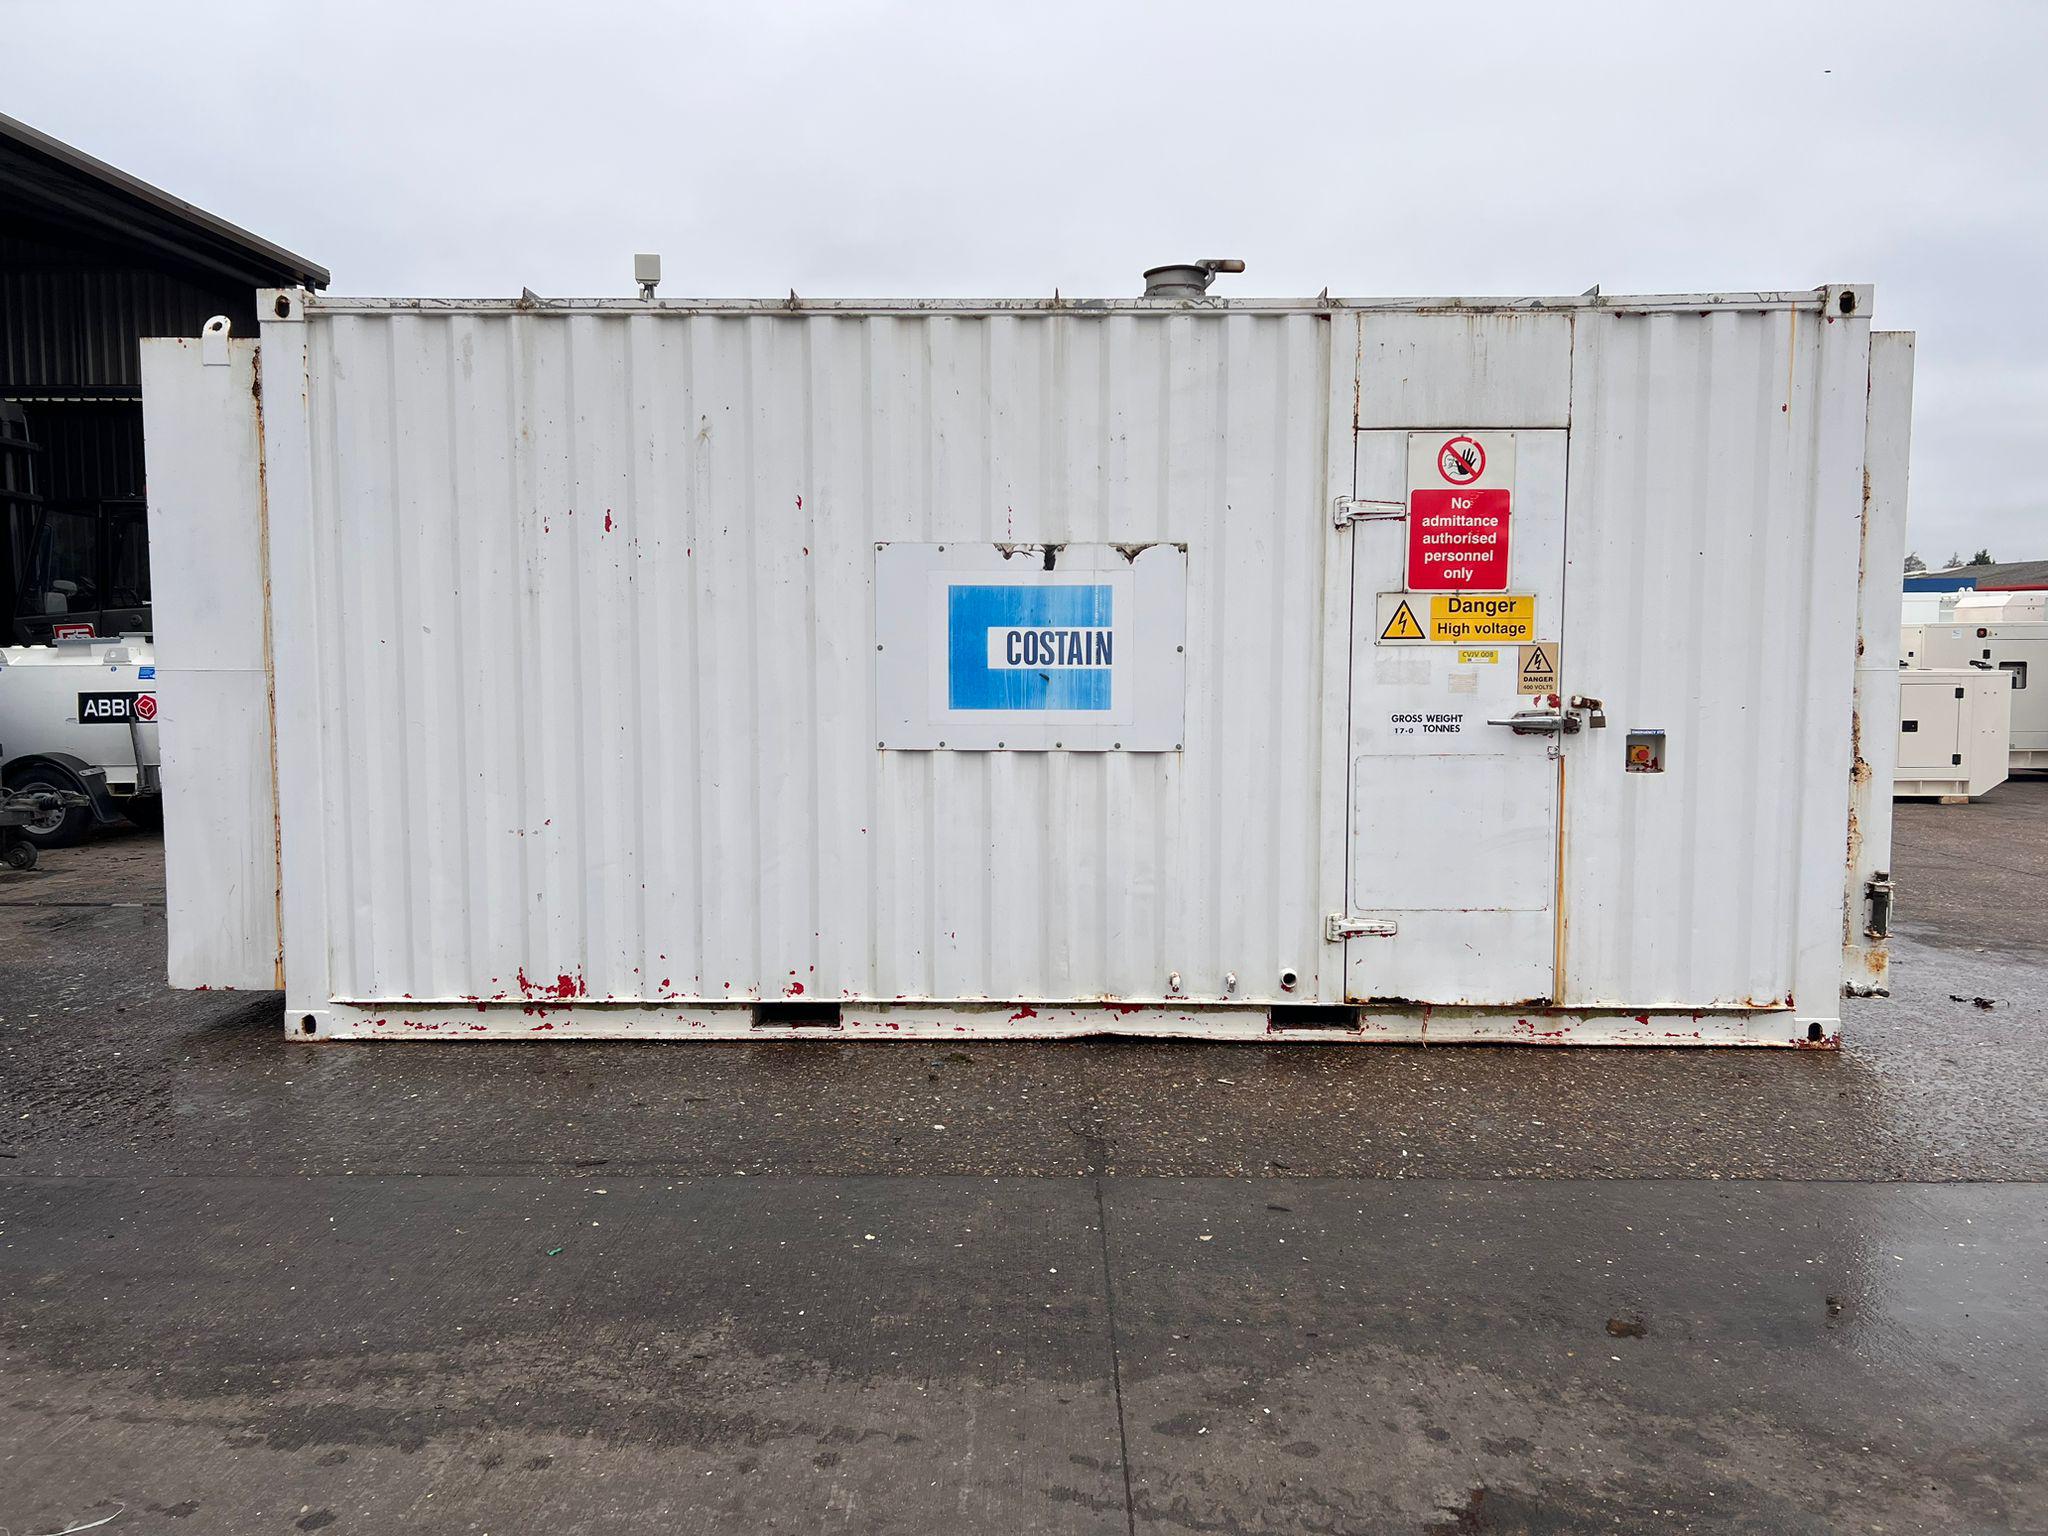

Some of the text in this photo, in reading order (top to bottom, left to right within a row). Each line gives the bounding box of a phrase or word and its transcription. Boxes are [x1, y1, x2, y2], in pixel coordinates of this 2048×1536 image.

[1451, 497, 1471, 509] No
[1422, 515, 1498, 527] admittance
[1422, 532, 1497, 544] authorised
[1424, 550, 1493, 564] personnel
[1443, 567, 1473, 581] only
[1448, 597, 1517, 617] Danger
[1437, 622, 1526, 637] High voltage
[1006, 630, 1112, 666] COSTAIN
[84, 699, 130, 717] ABBI
[1391, 714, 1463, 723] GROSS WEIGHT
[1422, 724, 1460, 733] TONNES
